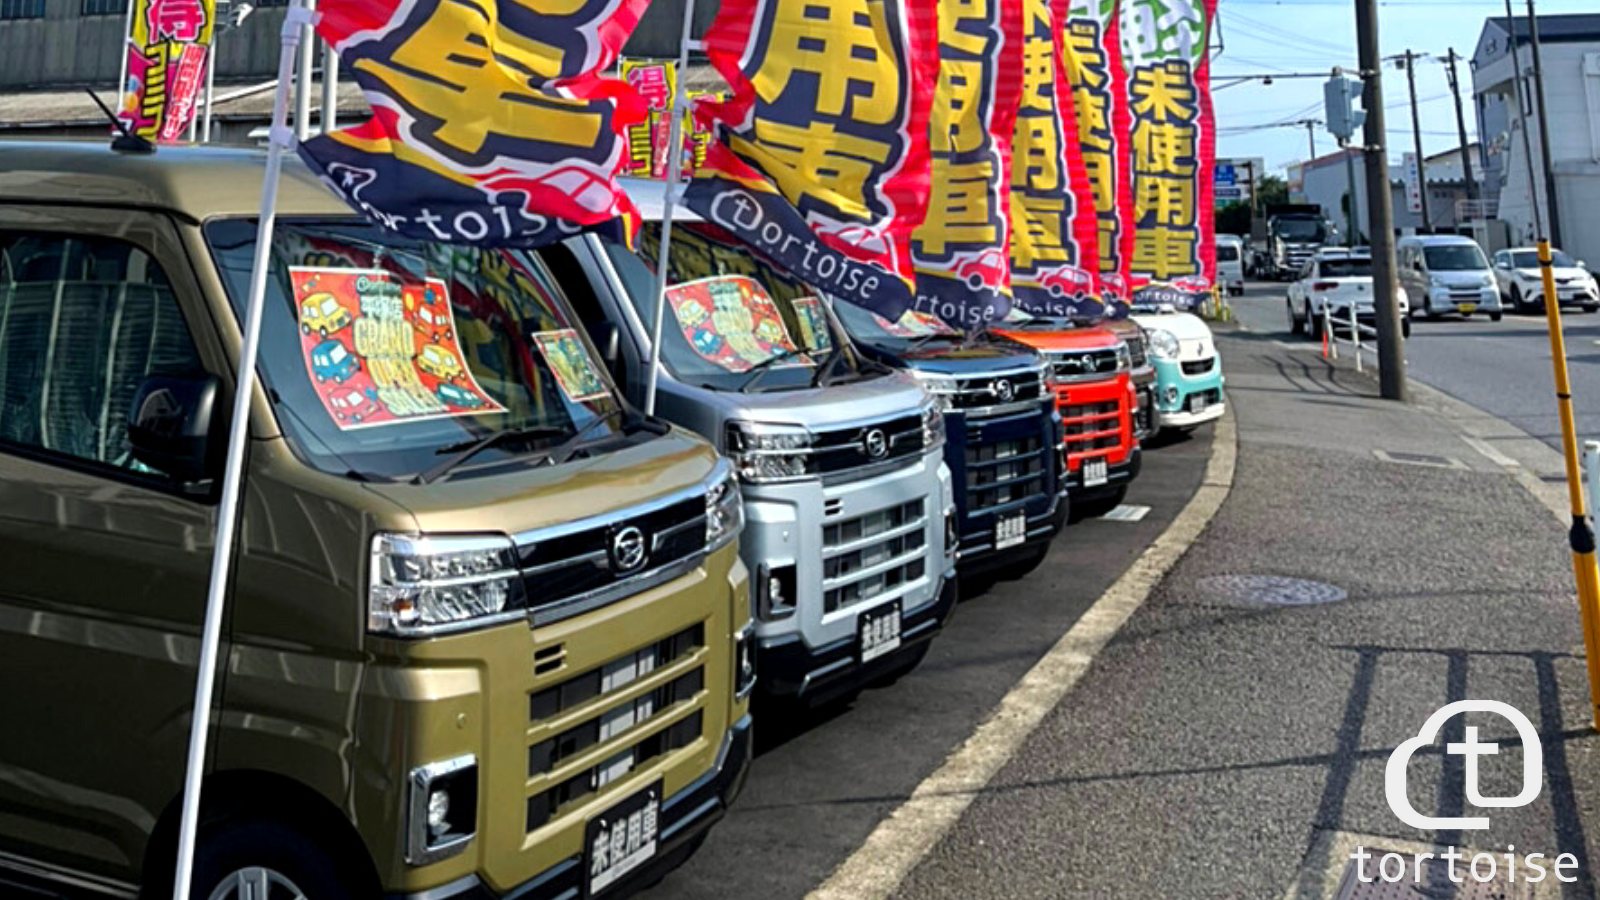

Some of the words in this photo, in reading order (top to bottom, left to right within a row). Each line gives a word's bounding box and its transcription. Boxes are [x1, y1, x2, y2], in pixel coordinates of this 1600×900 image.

[353, 0, 603, 154] 車
[1131, 63, 1196, 280] 未使用車
